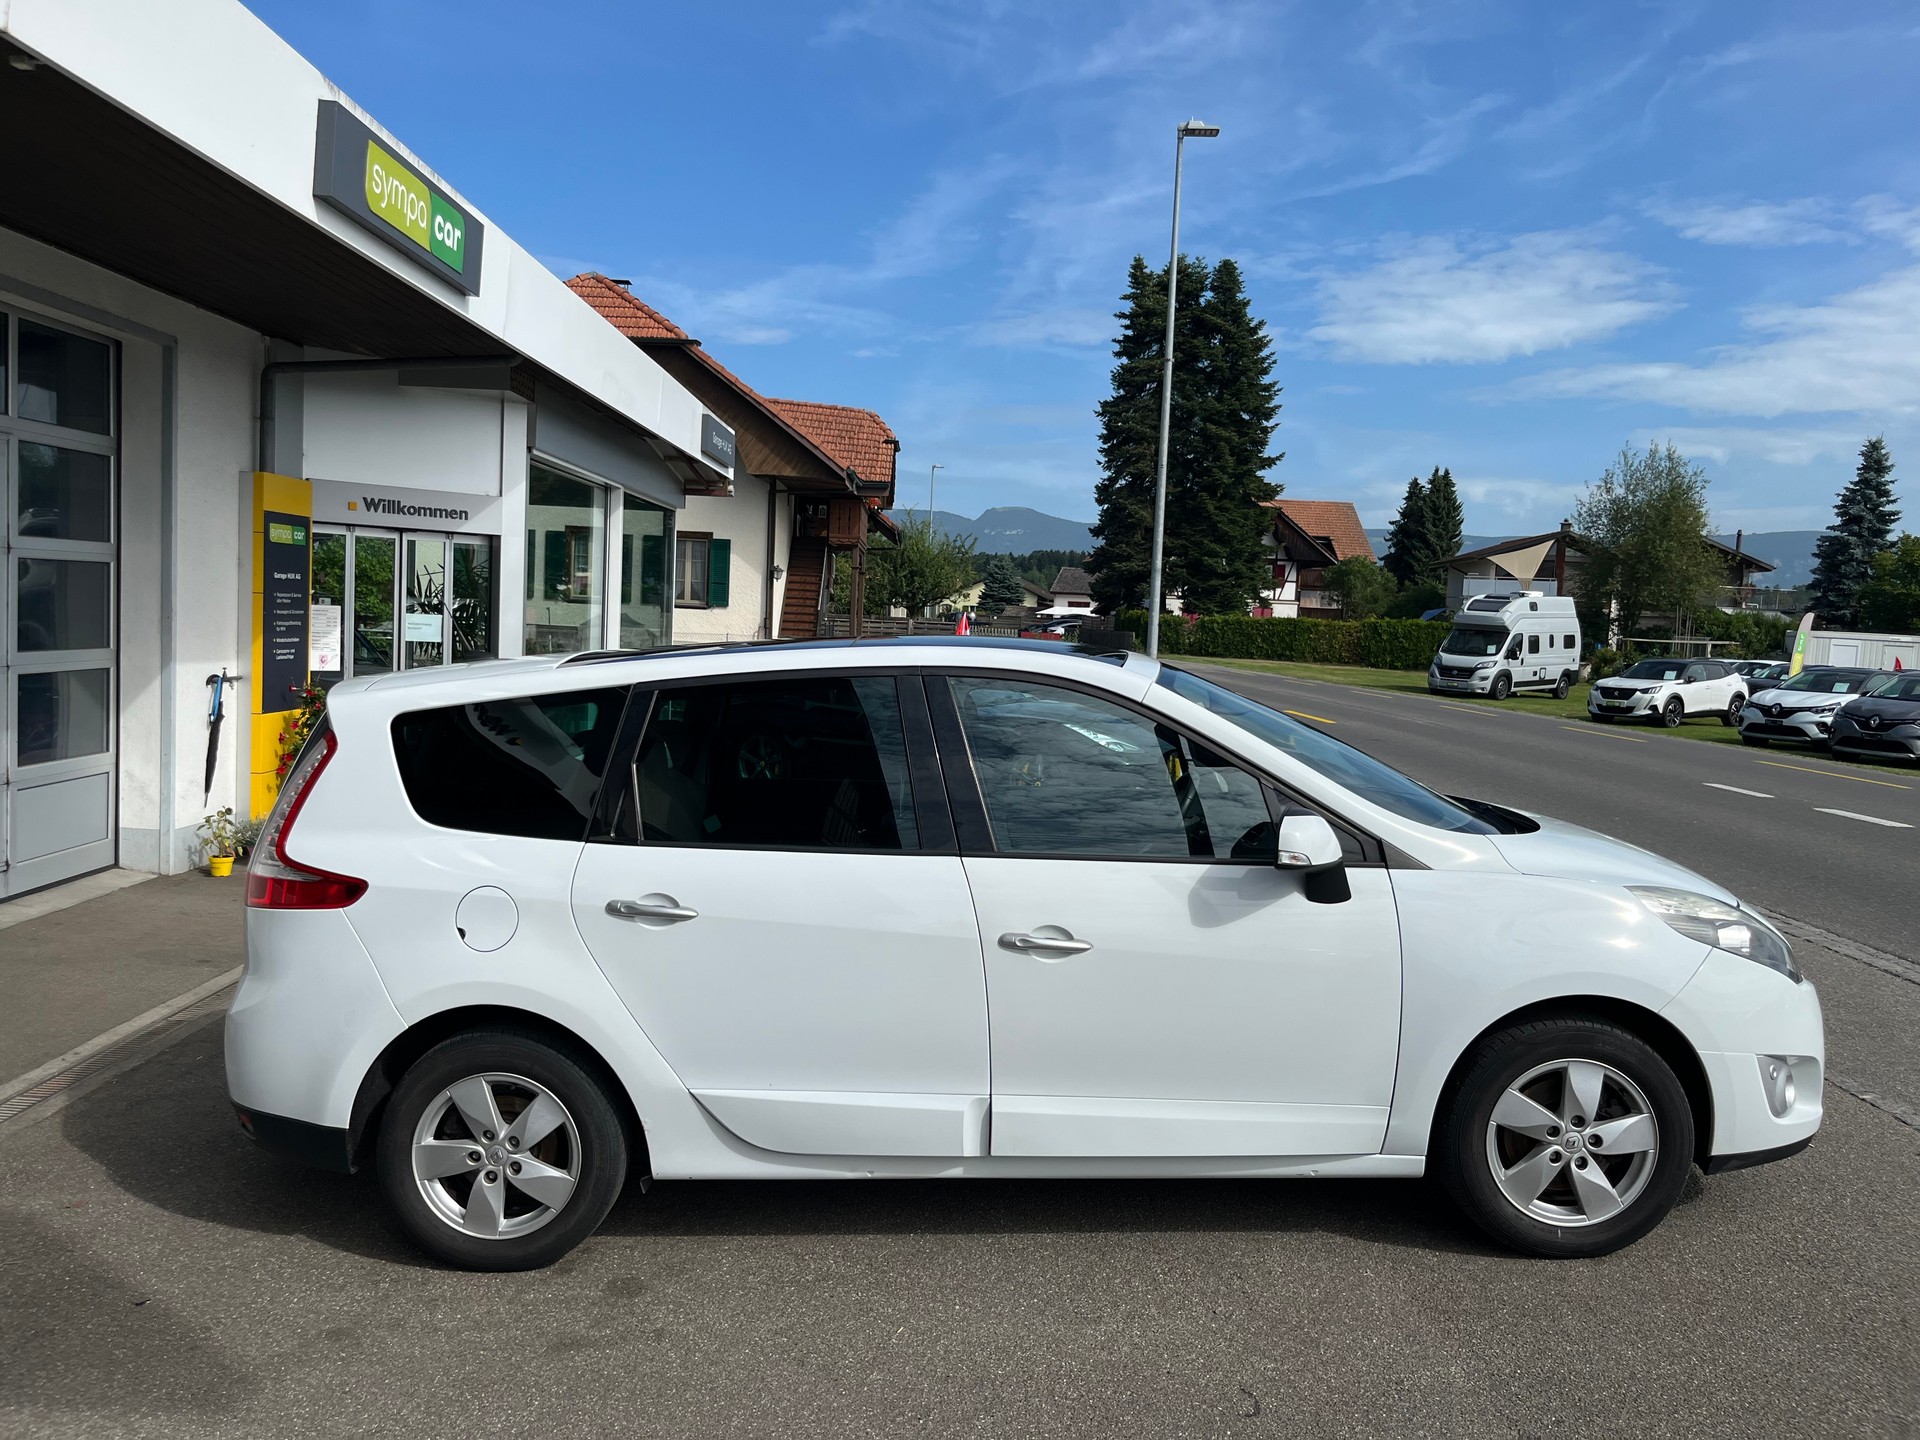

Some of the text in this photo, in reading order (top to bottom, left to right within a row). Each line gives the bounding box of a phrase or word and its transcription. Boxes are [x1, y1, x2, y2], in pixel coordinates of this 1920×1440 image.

[372, 164, 462, 252] sympa car
[362, 496, 469, 521] Willkommen
[271, 529, 305, 540] sympa car
